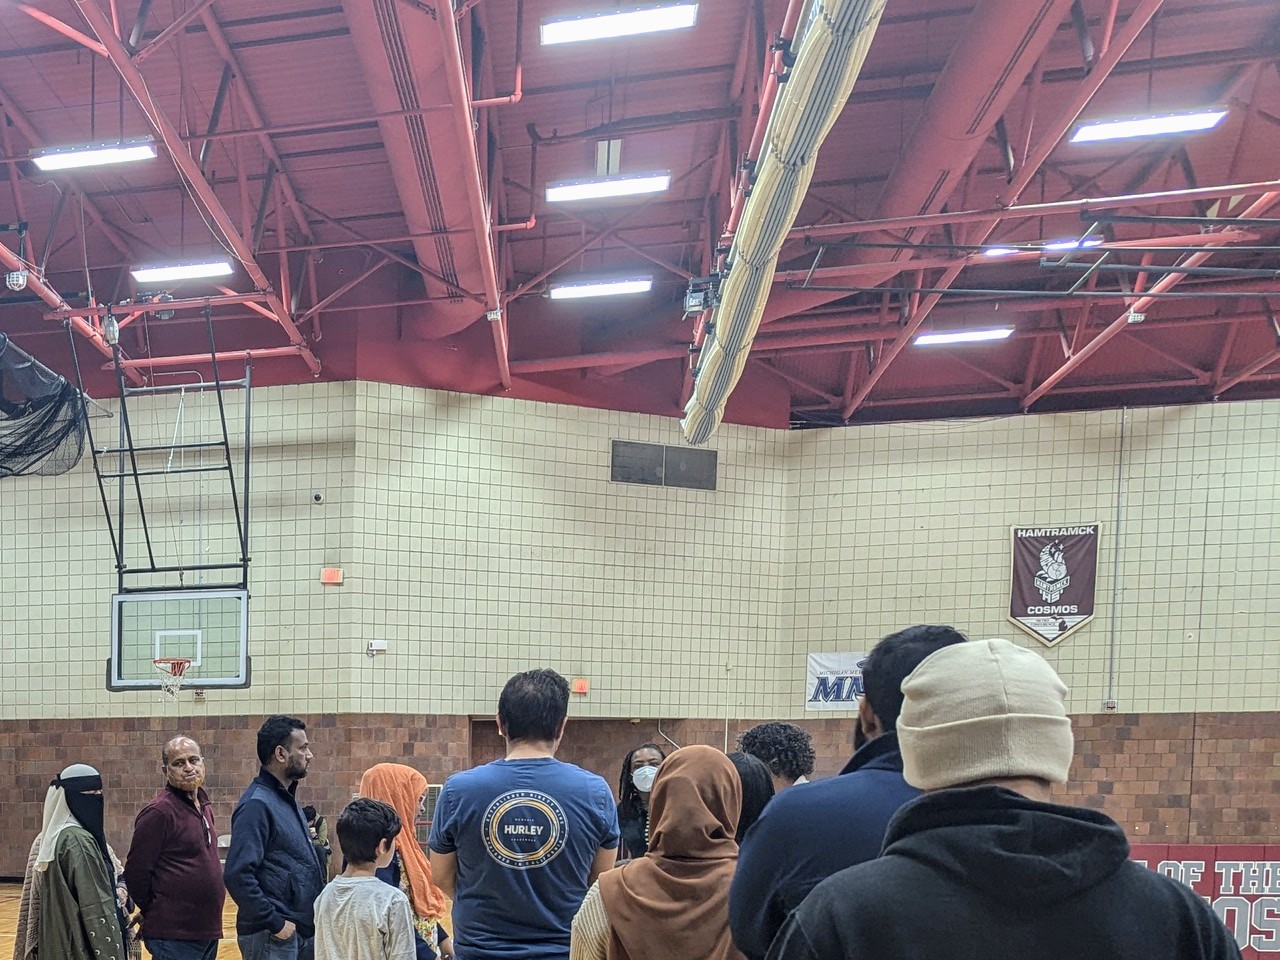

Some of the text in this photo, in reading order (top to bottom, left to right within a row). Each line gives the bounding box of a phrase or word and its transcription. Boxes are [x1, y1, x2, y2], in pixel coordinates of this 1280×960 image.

[1017, 526, 1095, 538] HAMTRAMCK
[1027, 605, 1078, 614] COSMOS
[808, 676, 866, 702] MM
[504, 825, 544, 835] HURLEY
